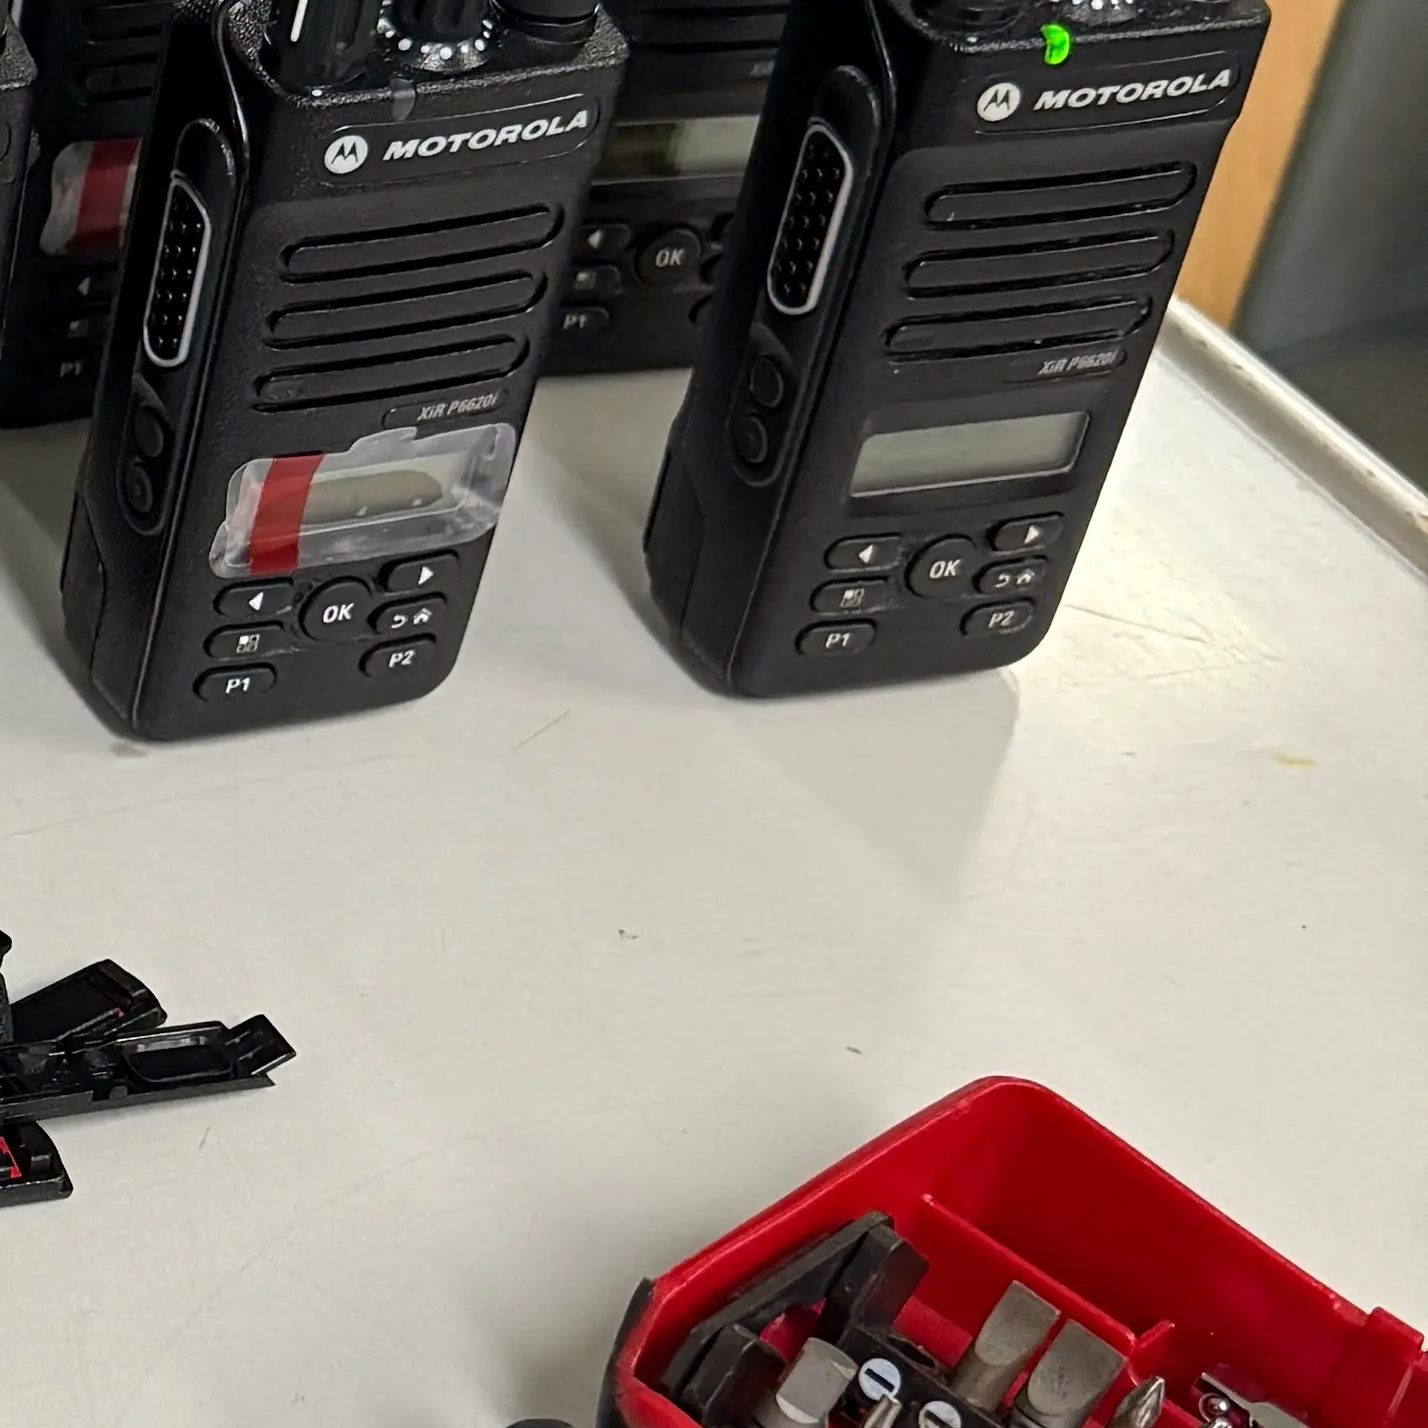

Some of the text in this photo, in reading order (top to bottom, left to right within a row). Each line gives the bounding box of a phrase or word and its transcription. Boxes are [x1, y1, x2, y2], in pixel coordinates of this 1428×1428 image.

[1032, 64, 1232, 111] MOTOROLA
[382, 106, 588, 164] MOTOROLA
[655, 246, 685, 268] OK
[417, 403, 446, 421] XiR
[929, 560, 961, 580] OK
[320, 601, 354, 624] OK
[988, 610, 1015, 628] P2
[825, 633, 850, 648] P1
[387, 648, 415, 669] P2
[224, 675, 252, 695] P1
